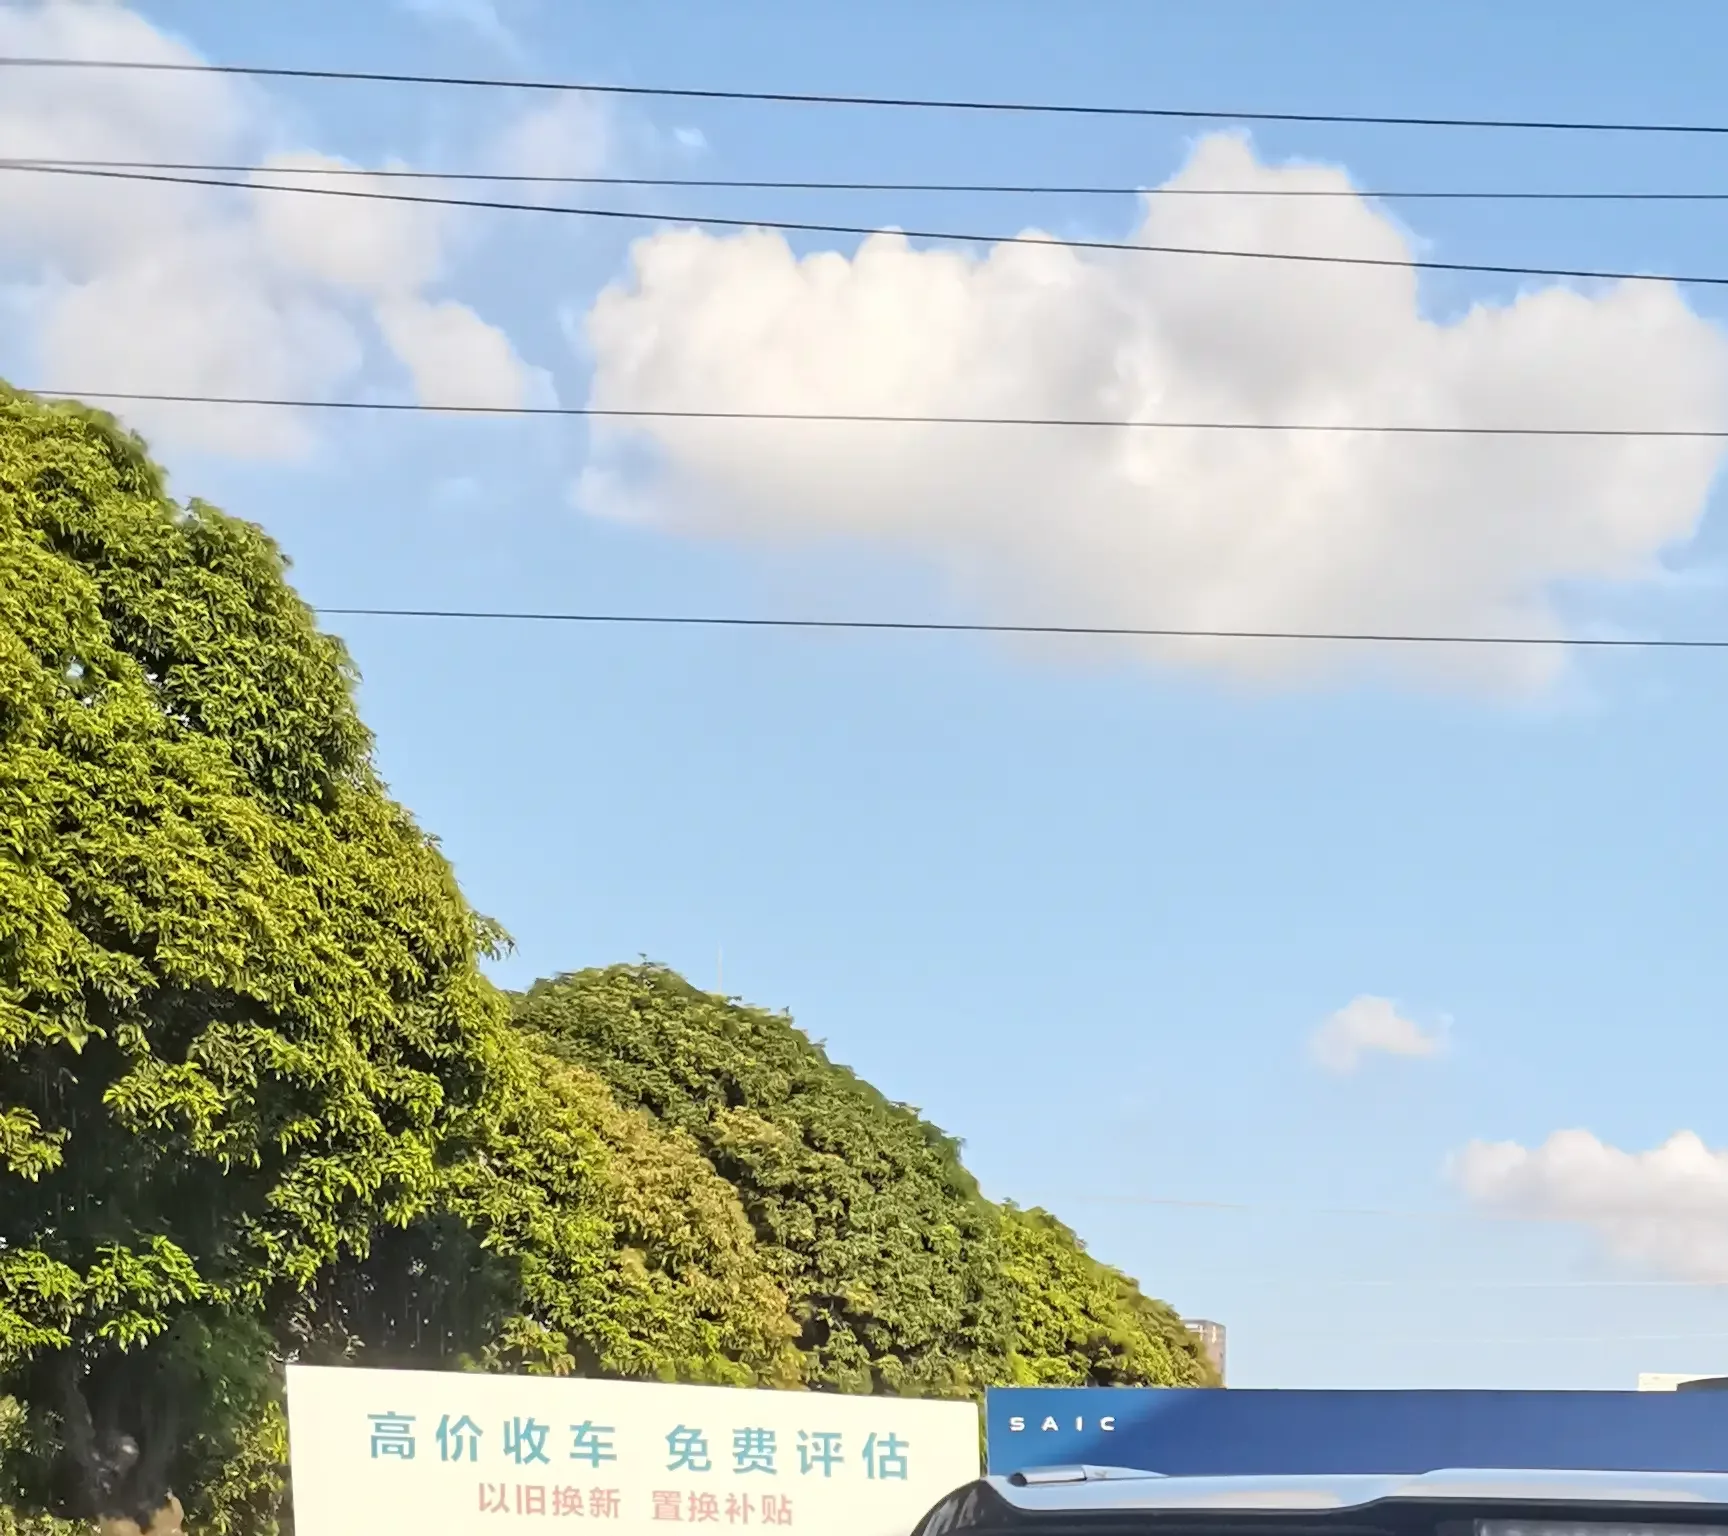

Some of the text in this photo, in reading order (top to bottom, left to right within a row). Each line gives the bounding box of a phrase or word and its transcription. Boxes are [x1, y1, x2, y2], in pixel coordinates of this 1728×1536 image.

[367, 1411, 910, 1480] 高价收车 免费评估
[1009, 1416, 1115, 1431] SAIC
[478, 1482, 793, 1526] 以旧换新 置换补贴
